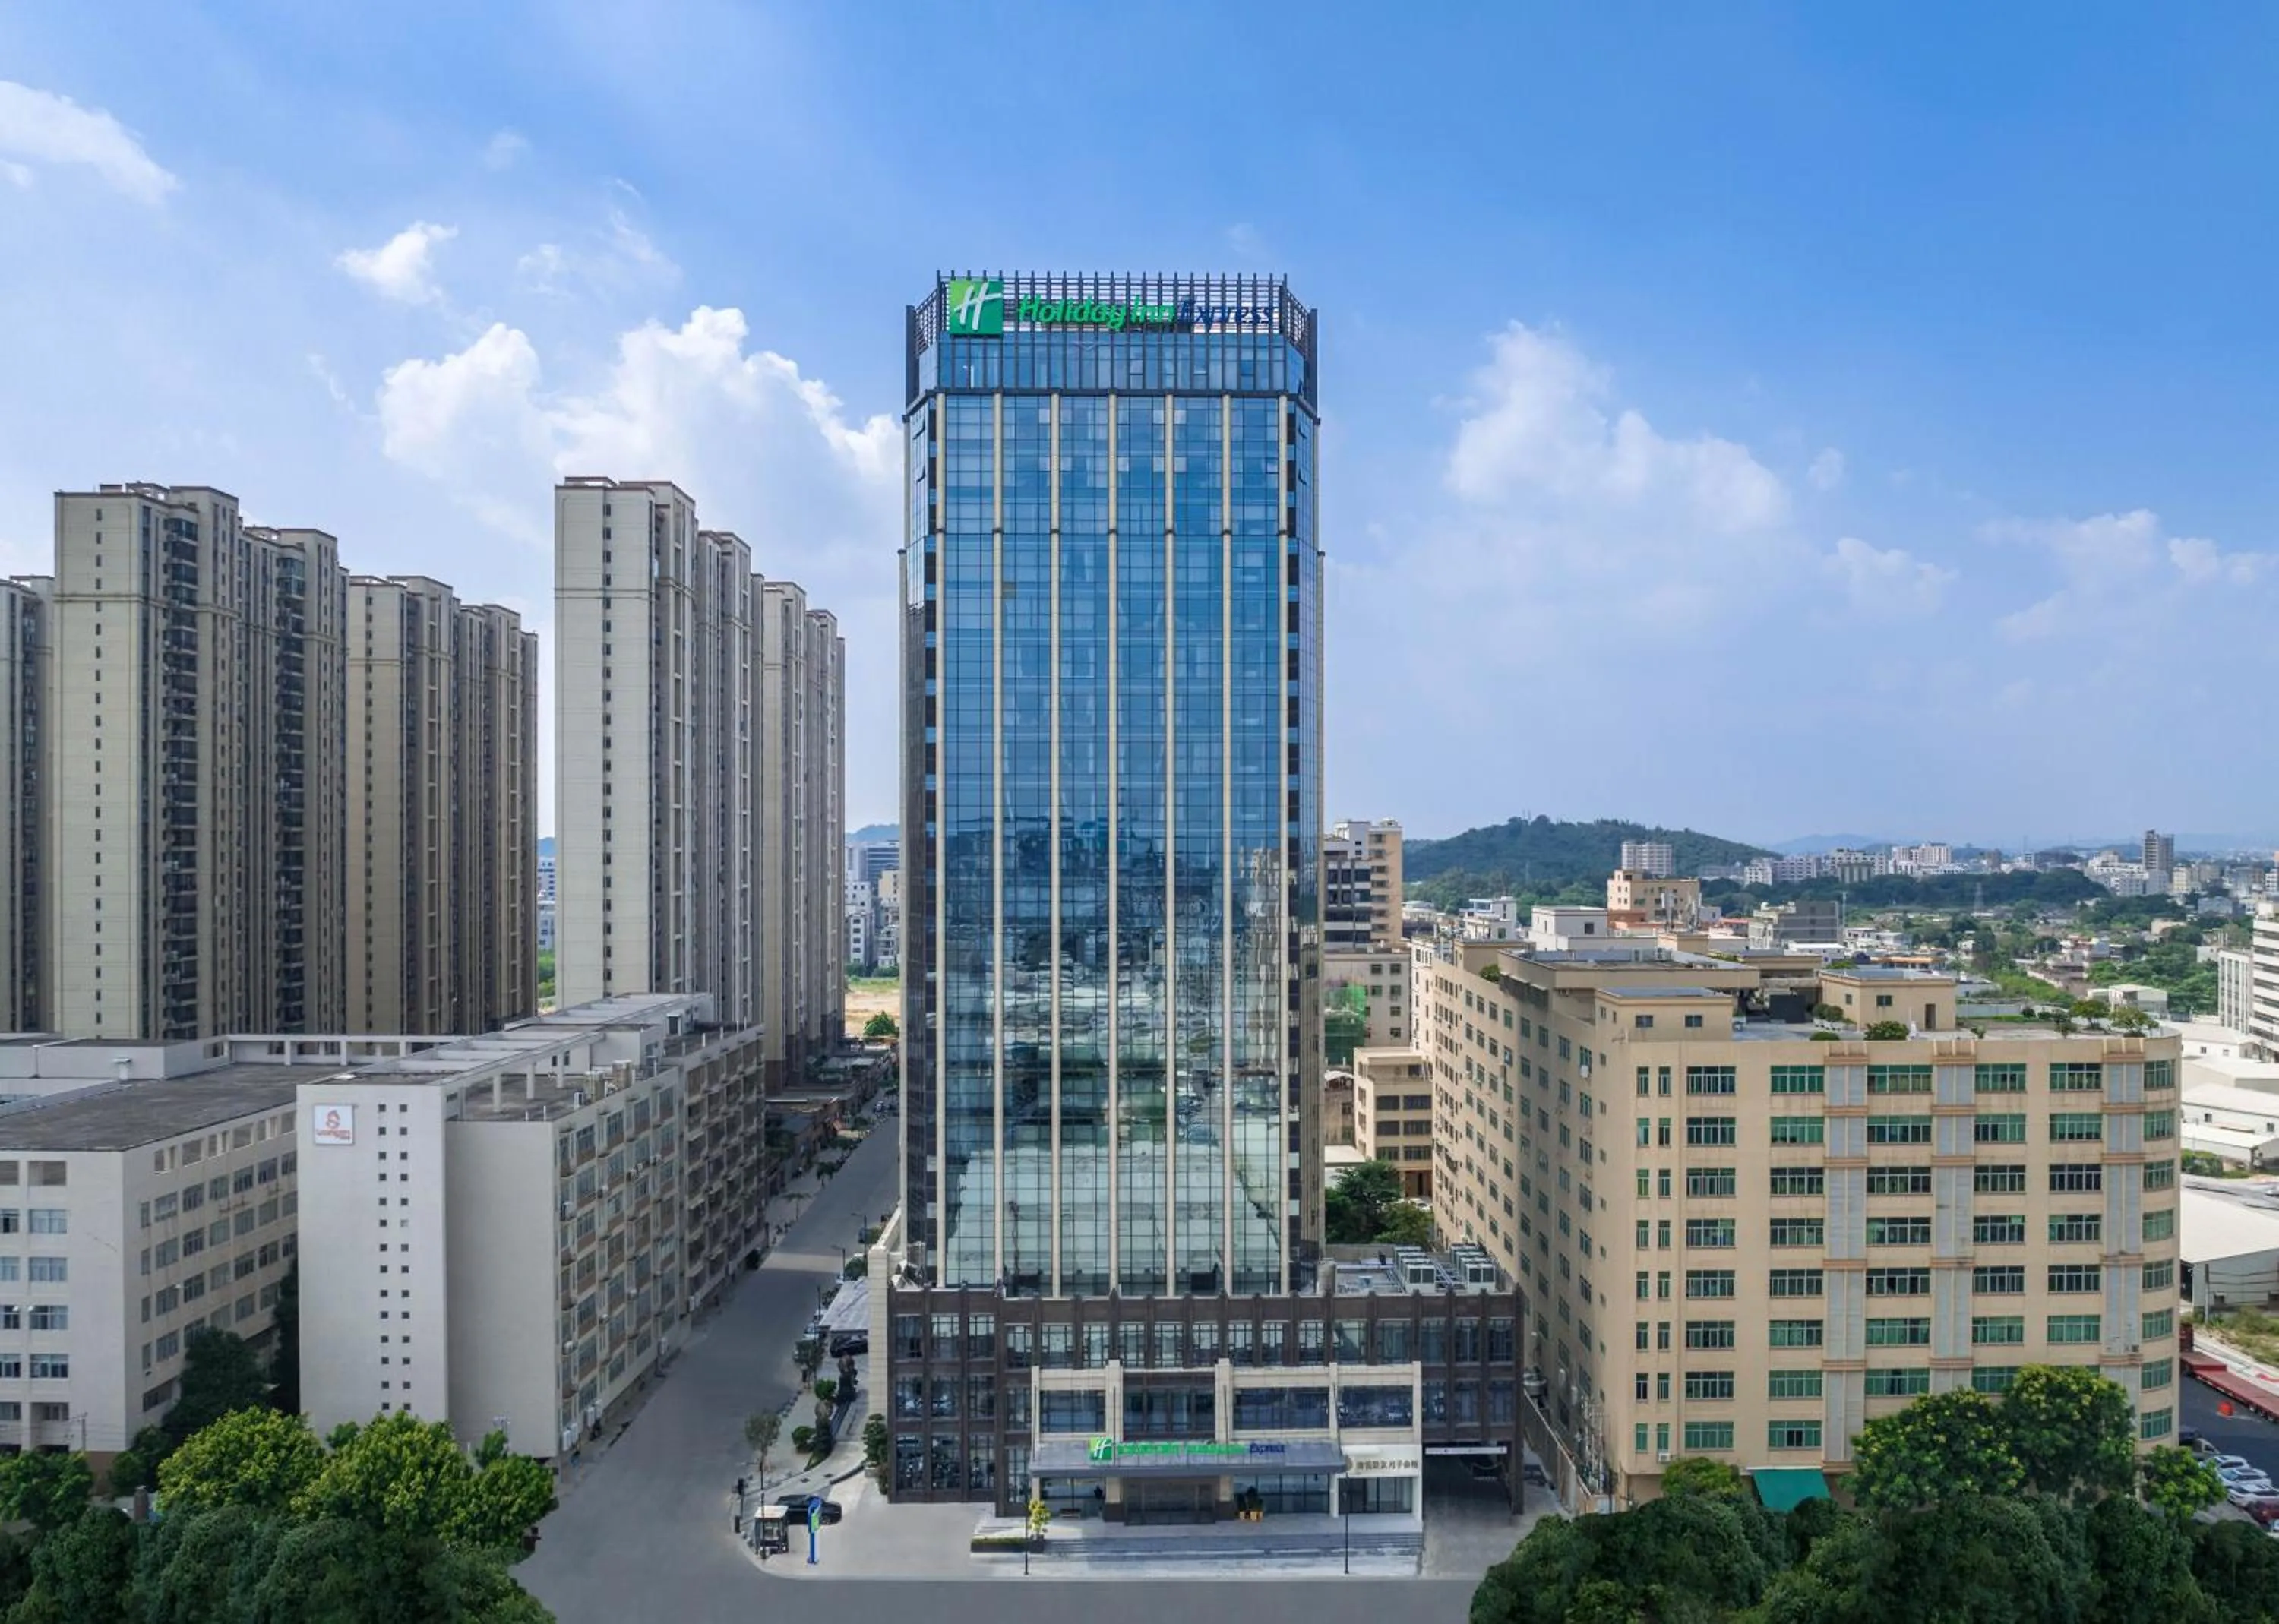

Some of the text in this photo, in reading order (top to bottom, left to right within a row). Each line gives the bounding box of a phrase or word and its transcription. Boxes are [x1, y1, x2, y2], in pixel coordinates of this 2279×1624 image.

[1017, 293, 1126, 330] Holiday
[1131, 294, 1175, 323] Inn
[1180, 297, 1277, 330] Express
